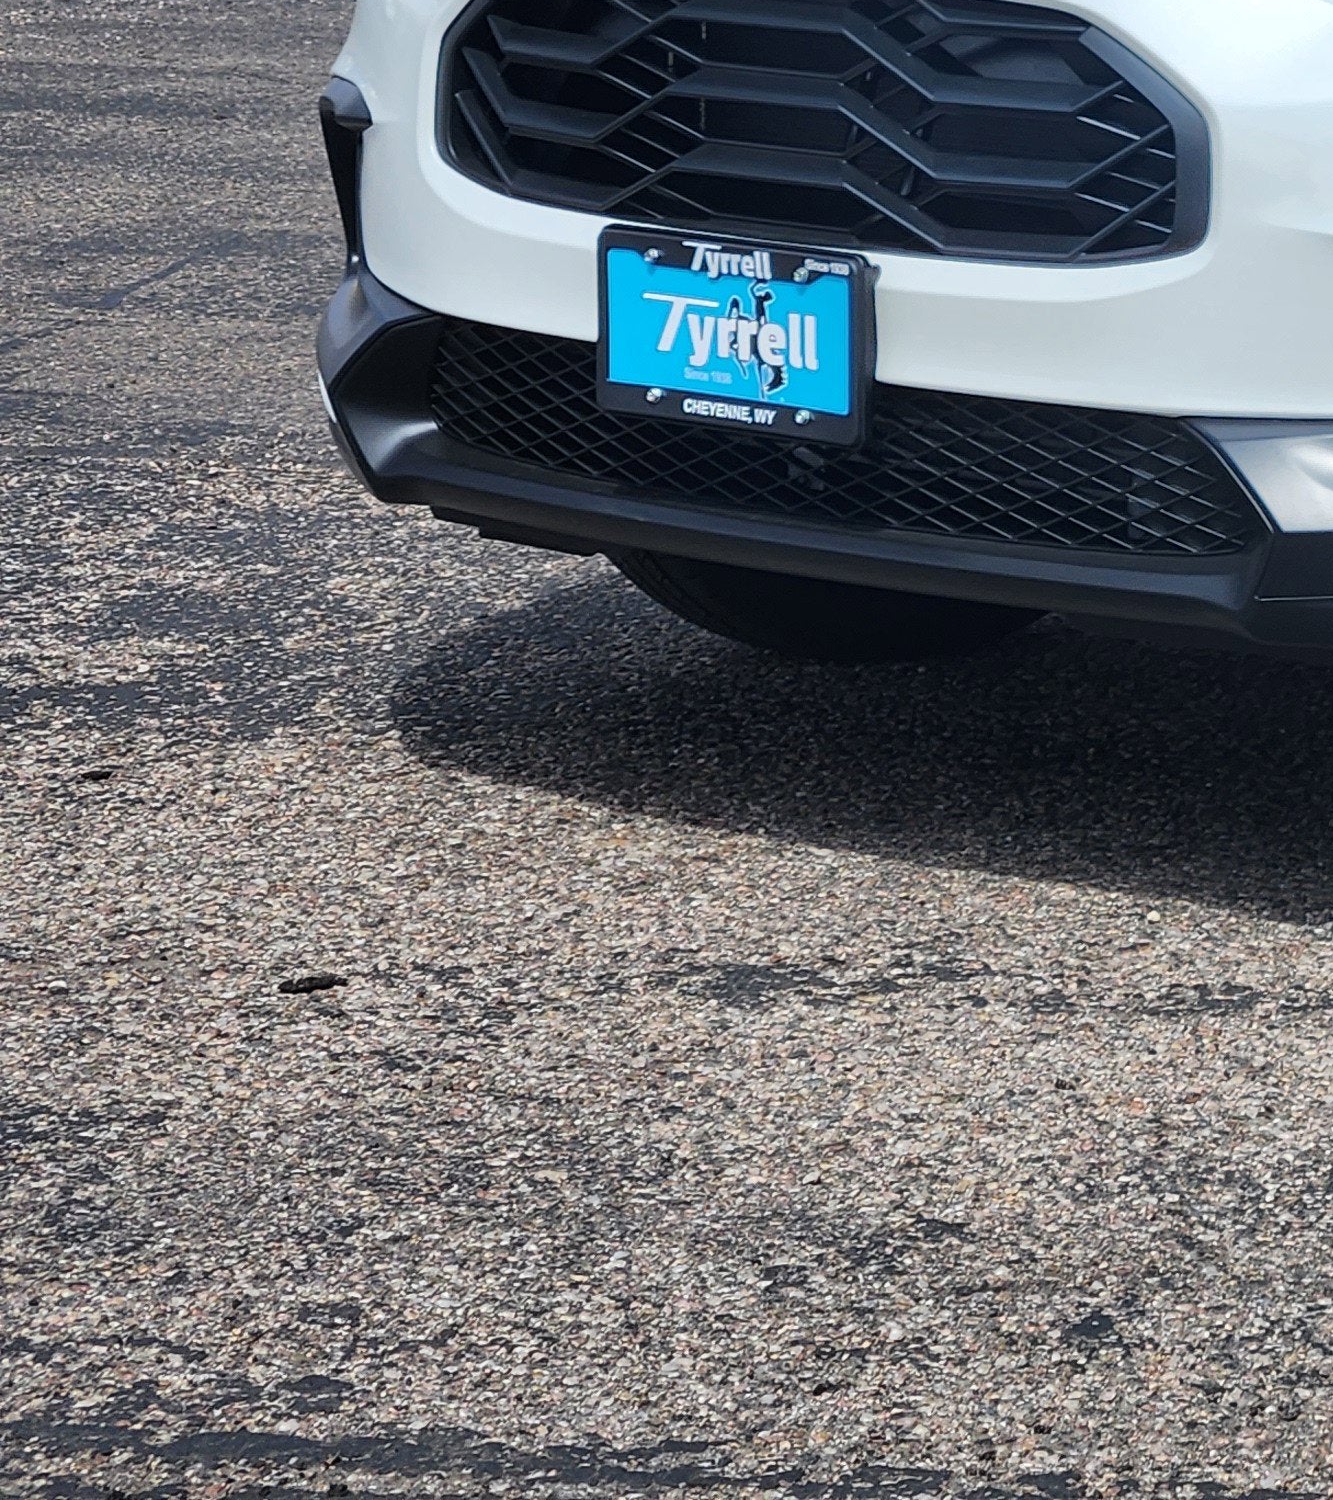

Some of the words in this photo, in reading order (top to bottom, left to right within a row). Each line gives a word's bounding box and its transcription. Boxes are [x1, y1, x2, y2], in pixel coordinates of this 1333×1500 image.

[682, 241, 772, 280] Tyrrell
[643, 292, 819, 370] Tyrrell
[682, 398, 752, 424] CHEYENNE,
[753, 408, 778, 425] WY
